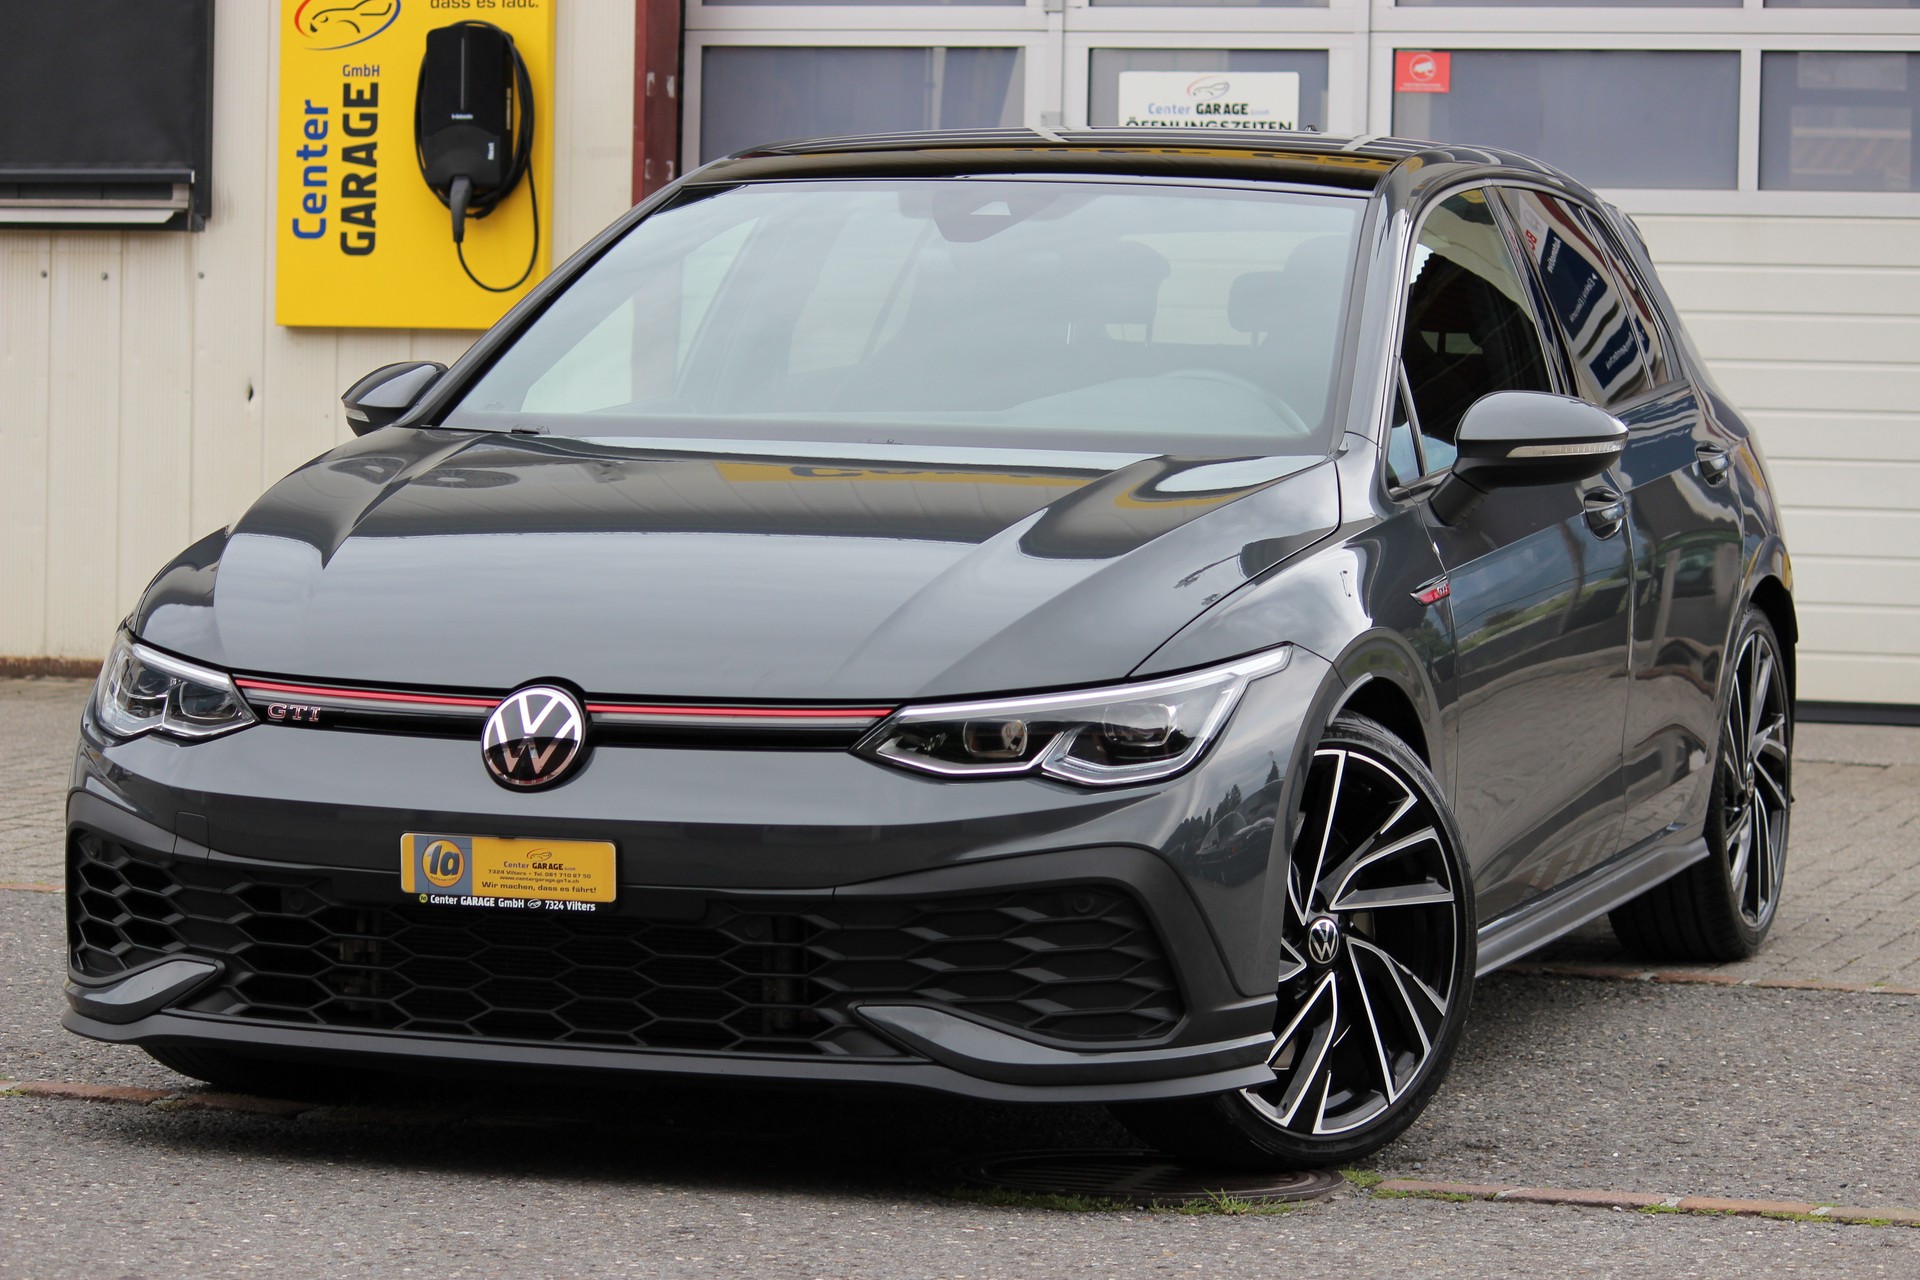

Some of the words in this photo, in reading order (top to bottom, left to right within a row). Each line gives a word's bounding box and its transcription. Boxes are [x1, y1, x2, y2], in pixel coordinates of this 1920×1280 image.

[476, 0, 496, 9] es
[342, 64, 380, 77] GmbH
[1148, 102, 1190, 115] Center
[1196, 103, 1249, 115] GARAGE
[292, 99, 329, 240] Center
[340, 82, 379, 256] GARAGE
[267, 702, 321, 722] GTI
[503, 861, 530, 869] Center
[532, 862, 564, 870] GARAGE
[481, 881, 499, 889] Wir
[500, 883, 536, 891] machen,
[537, 884, 558, 892] dass
[430, 894, 458, 905] Center
[460, 896, 496, 907] GARAGE
[498, 897, 525, 908] GmbH
[545, 900, 565, 910] 7324
[566, 901, 597, 912] Vilters
